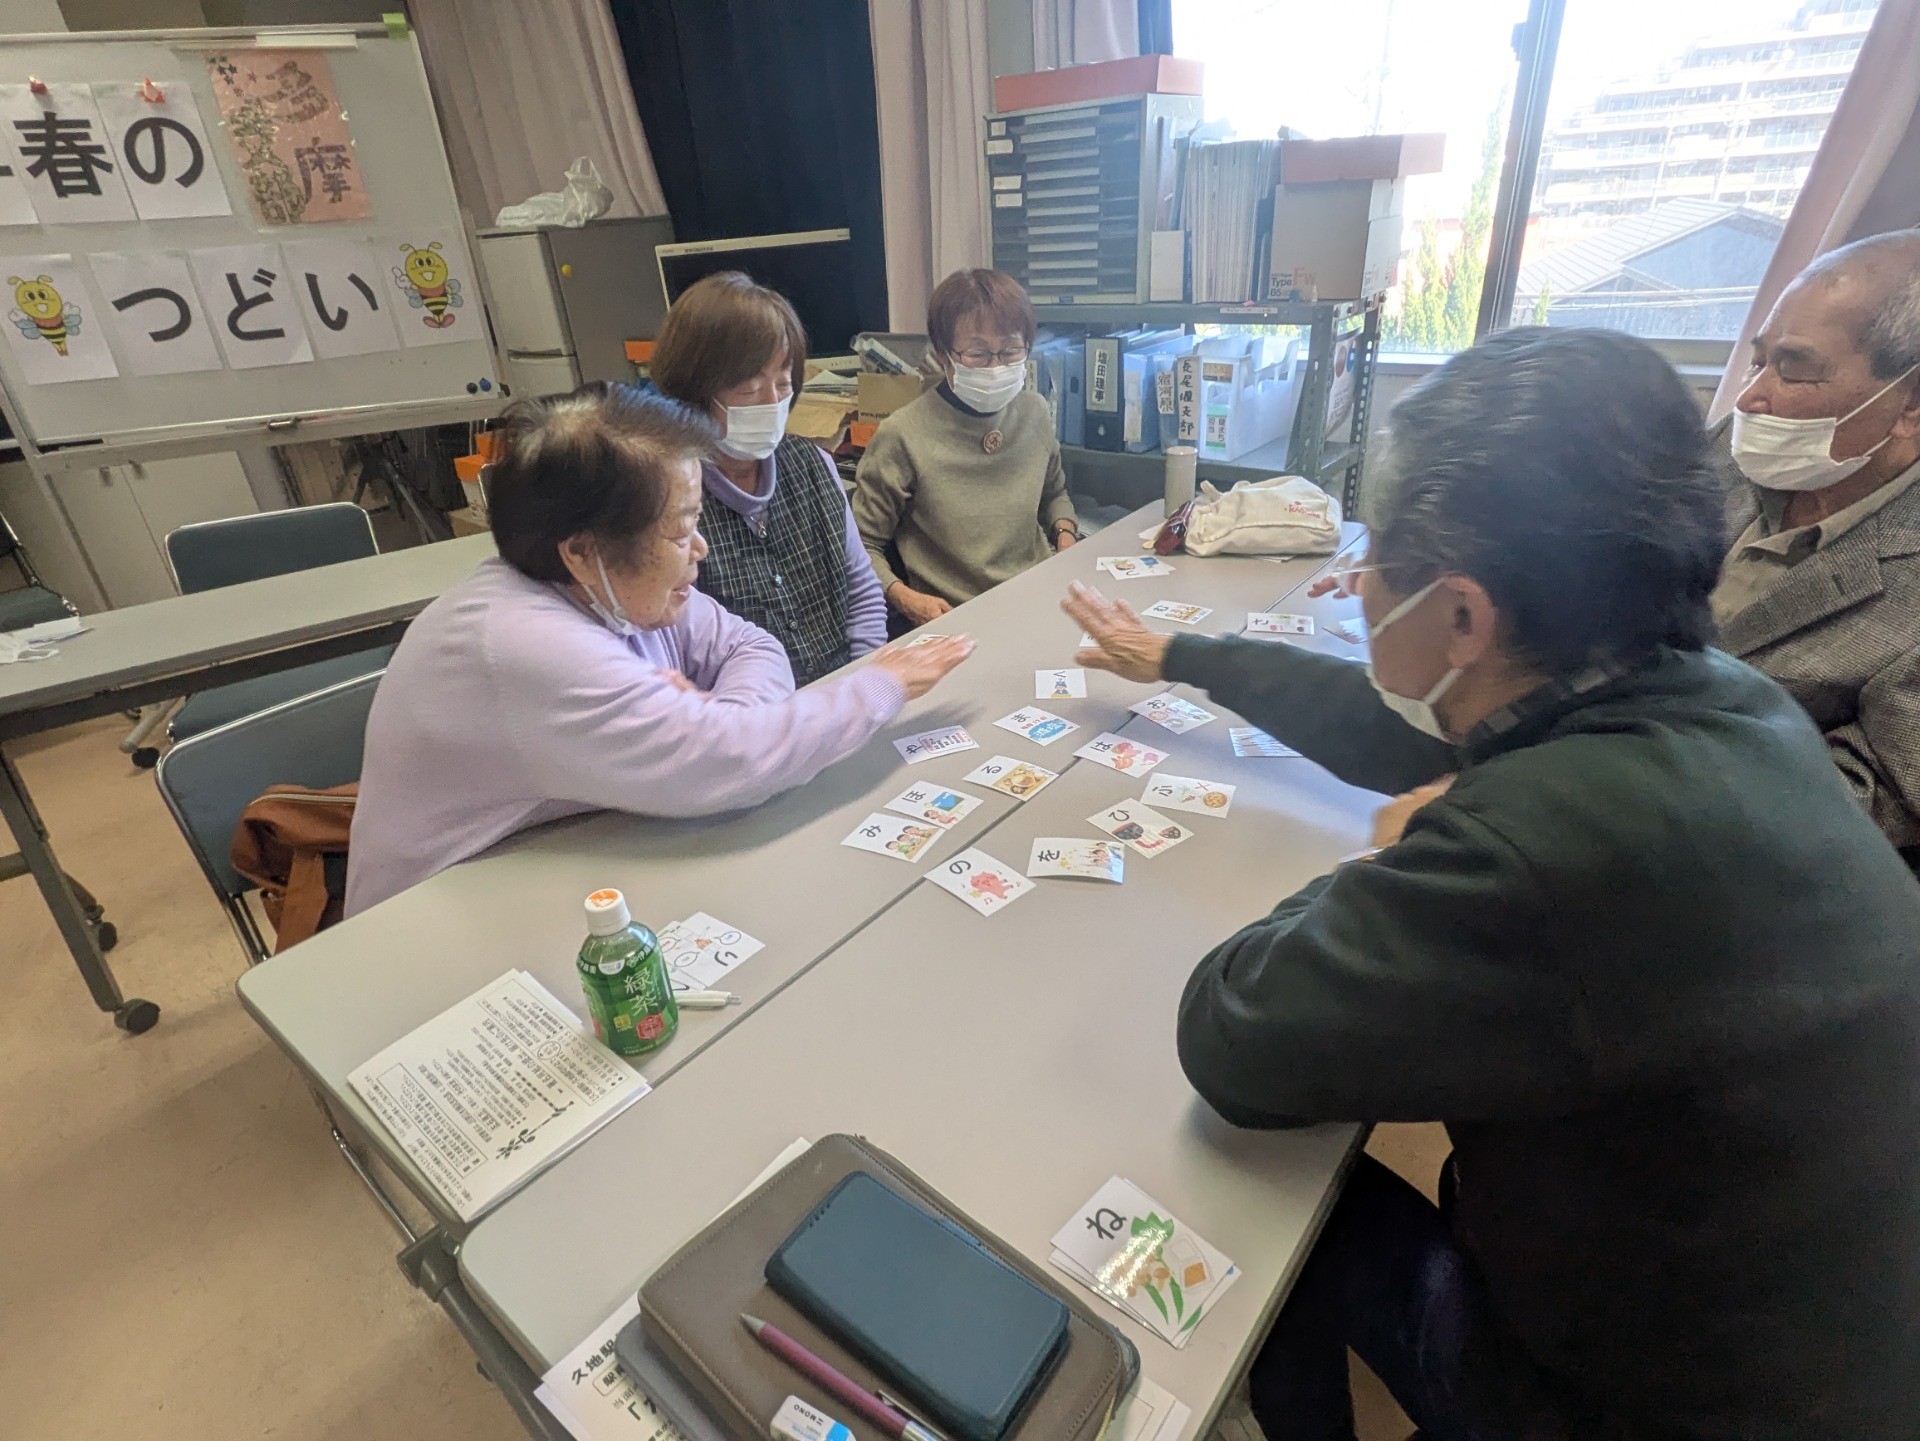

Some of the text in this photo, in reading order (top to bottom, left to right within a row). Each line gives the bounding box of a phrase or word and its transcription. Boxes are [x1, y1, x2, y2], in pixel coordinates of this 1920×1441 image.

[0, 111, 204, 198] 春の
[1271, 277, 1292, 287] Type
[111, 267, 379, 343] つどい
[1053, 670, 1066, 678] く
[1011, 713, 1031, 723] ま
[1090, 741, 1113, 753] は
[980, 765, 1002, 774] る
[902, 790, 927, 803] ほ
[1152, 785, 1173, 796] ふ
[1108, 809, 1130, 821] ひ
[859, 825, 882, 837] み
[1037, 850, 1060, 862] を
[949, 860, 971, 875] の
[714, 951, 738, 966] り
[624, 966, 658, 1017] 緑茶
[1085, 1208, 1127, 1240] ね
[794, 1404, 817, 1421] MONO
